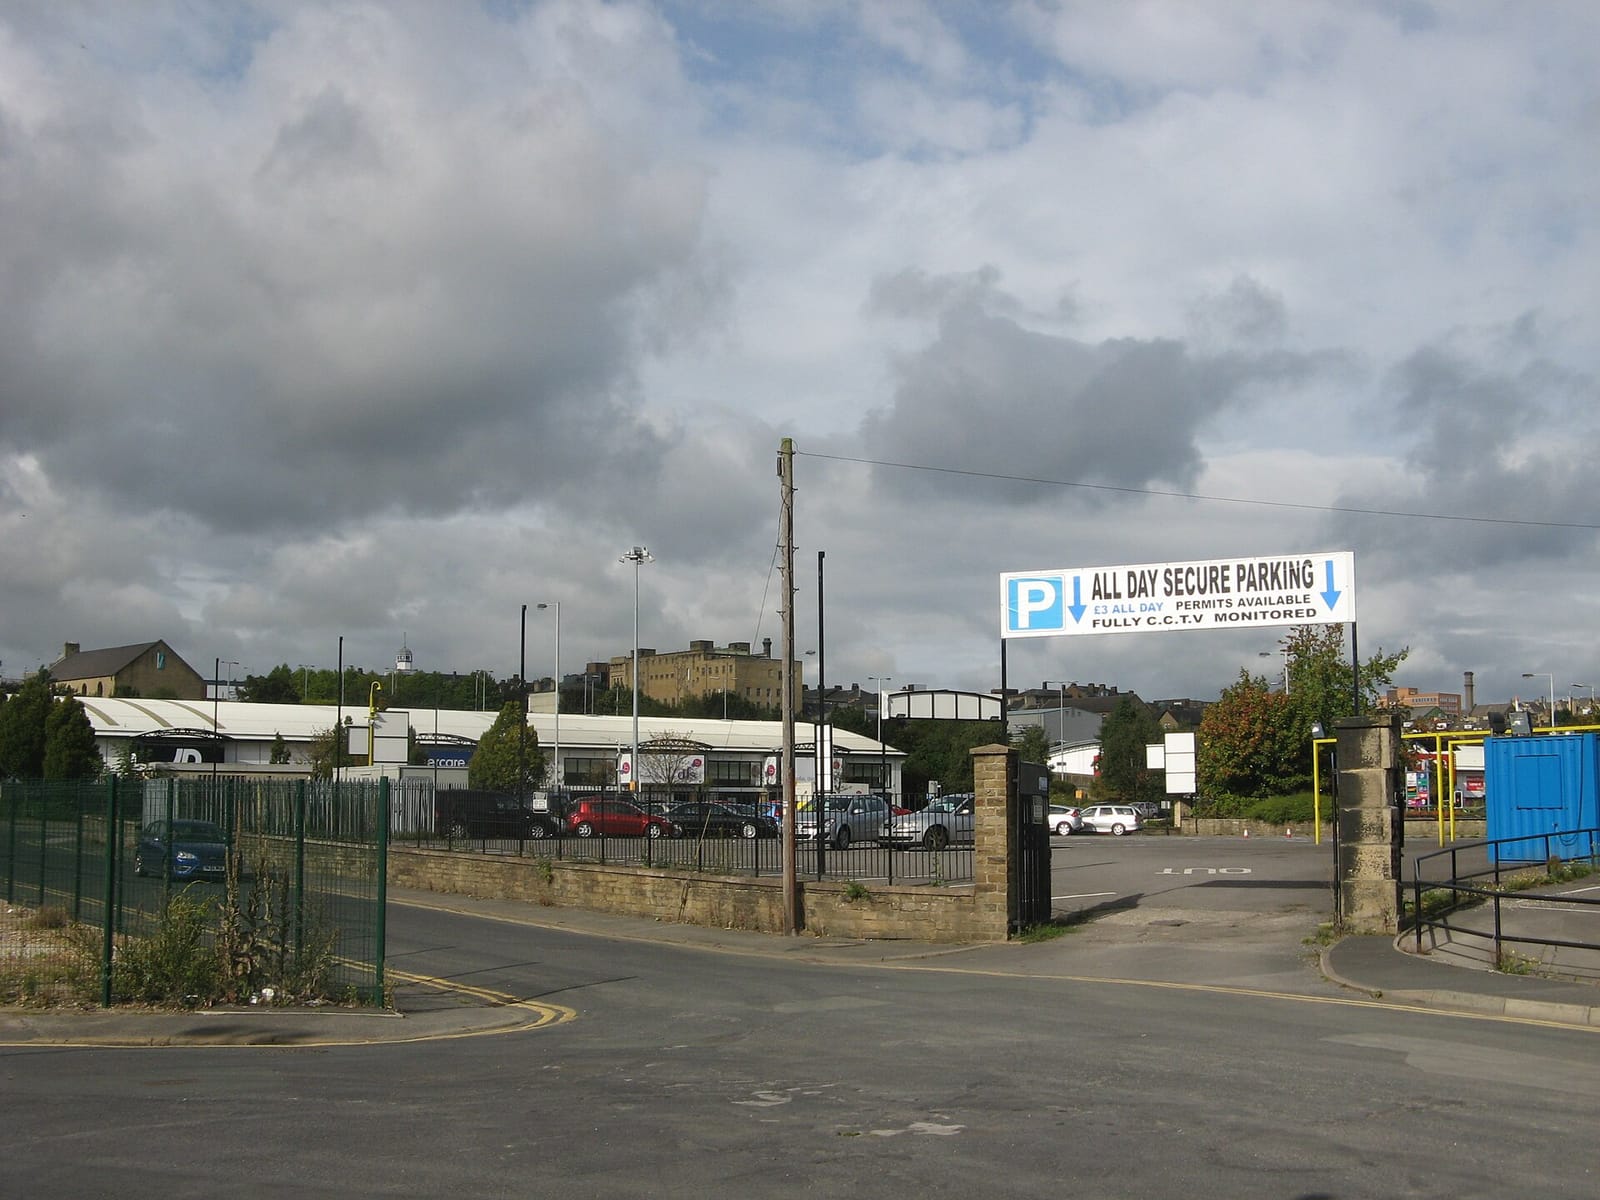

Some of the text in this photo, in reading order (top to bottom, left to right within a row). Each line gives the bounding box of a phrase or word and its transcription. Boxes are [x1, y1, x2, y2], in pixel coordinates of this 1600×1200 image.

[1092, 559, 1314, 600] ALL DAY SECURE PARKING
[1017, 581, 1055, 628] P
[1092, 607, 1317, 628] FULLY C.C.T.V MONITORED
[1094, 594, 1311, 615] £3 ALL DAY PERMITS AVAILABLE
